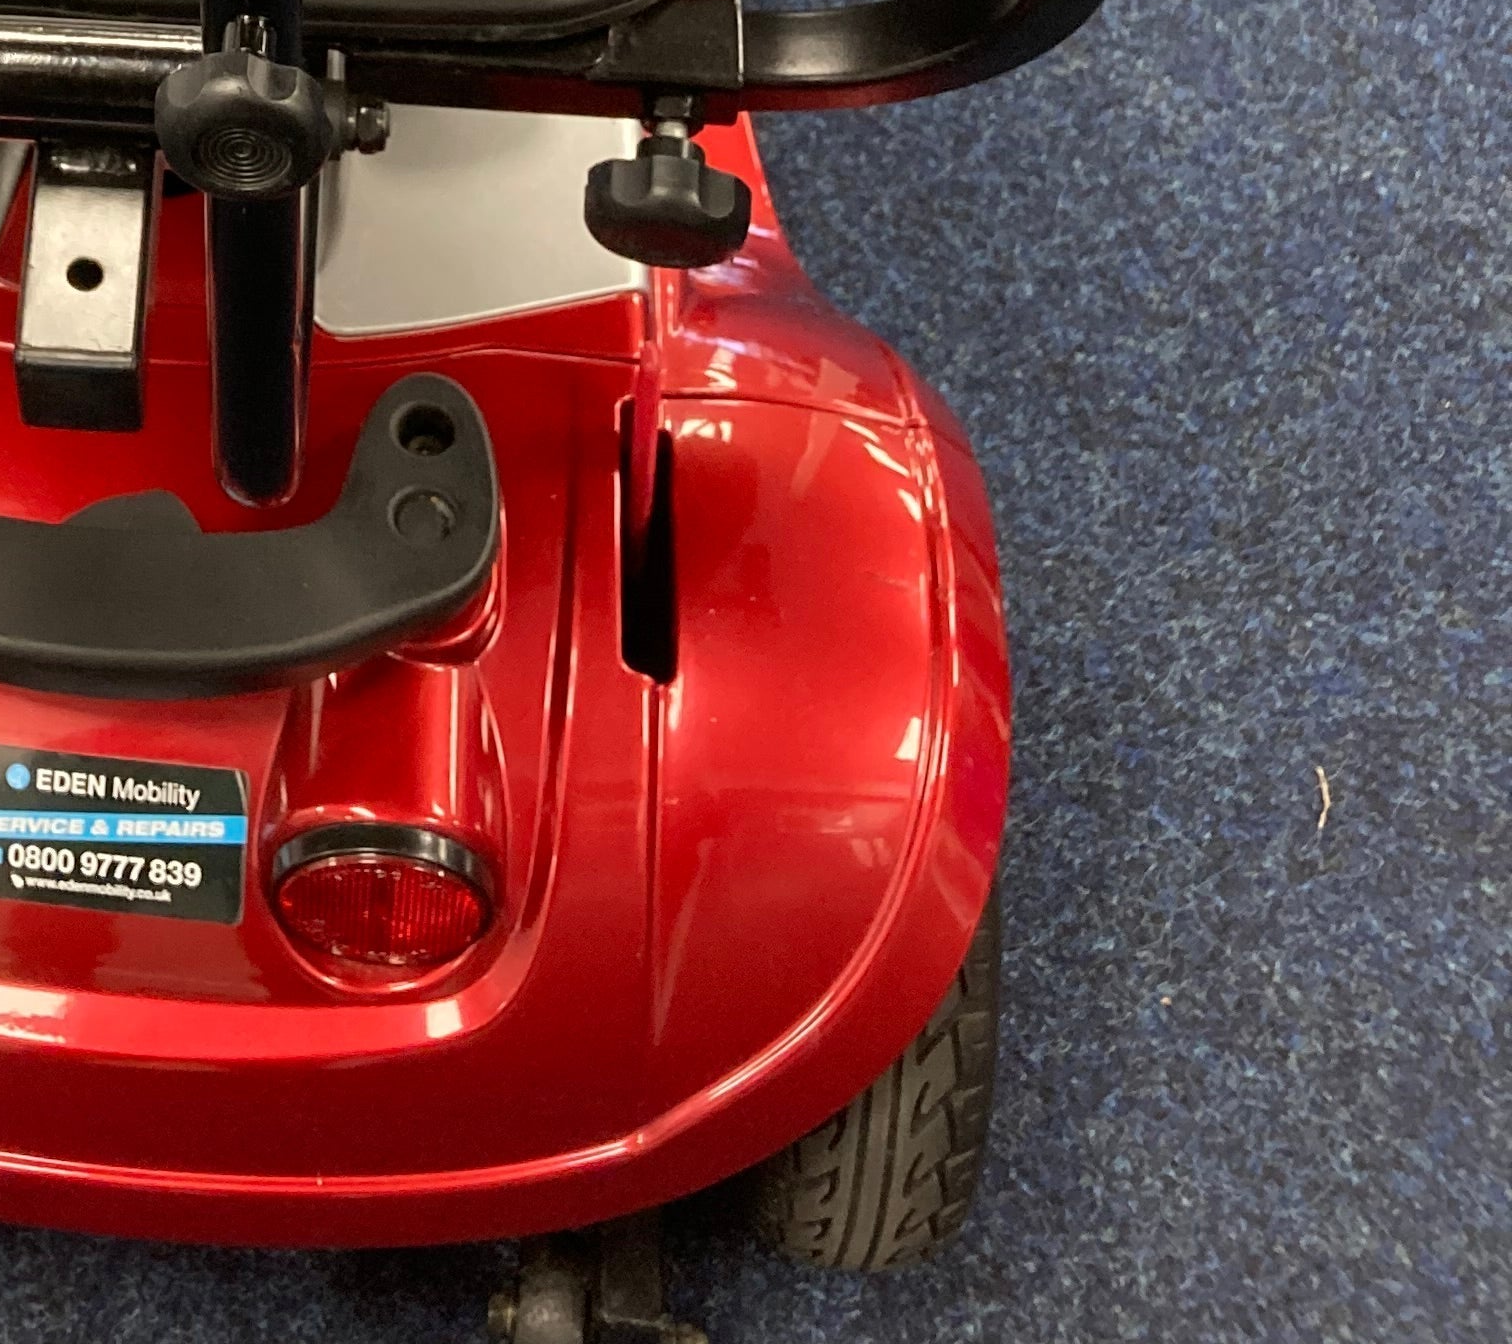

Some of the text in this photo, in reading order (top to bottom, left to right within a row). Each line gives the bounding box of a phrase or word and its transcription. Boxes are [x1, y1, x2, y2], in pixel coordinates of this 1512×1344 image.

[36, 767, 201, 811] EDEN Mobility
[90, 819, 109, 837] &
[116, 820, 225, 838] REPAIRS
[7, 843, 202, 888] 0800 9777 839
